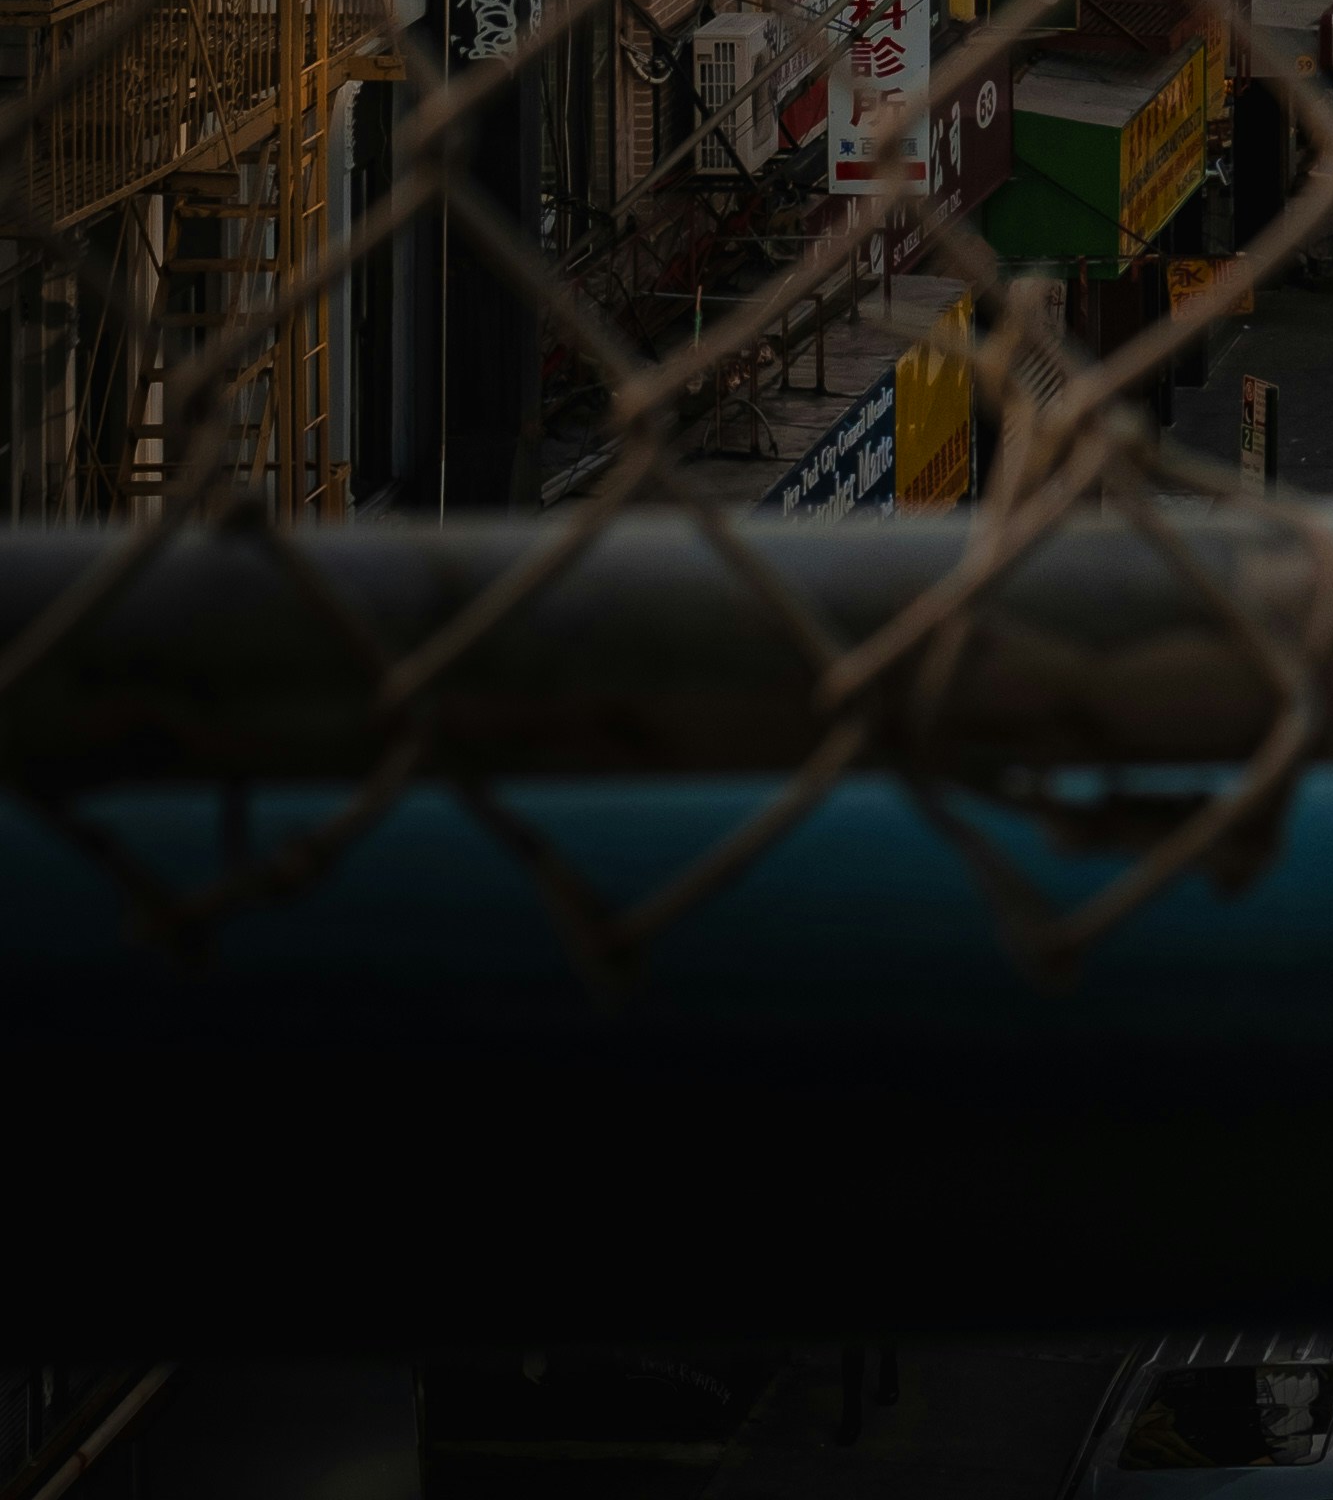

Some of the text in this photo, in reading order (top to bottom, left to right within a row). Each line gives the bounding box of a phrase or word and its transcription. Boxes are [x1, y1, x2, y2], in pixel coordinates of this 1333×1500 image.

[821, 444, 838, 475] City
[838, 407, 866, 457] Council
[857, 434, 893, 500] Marte
